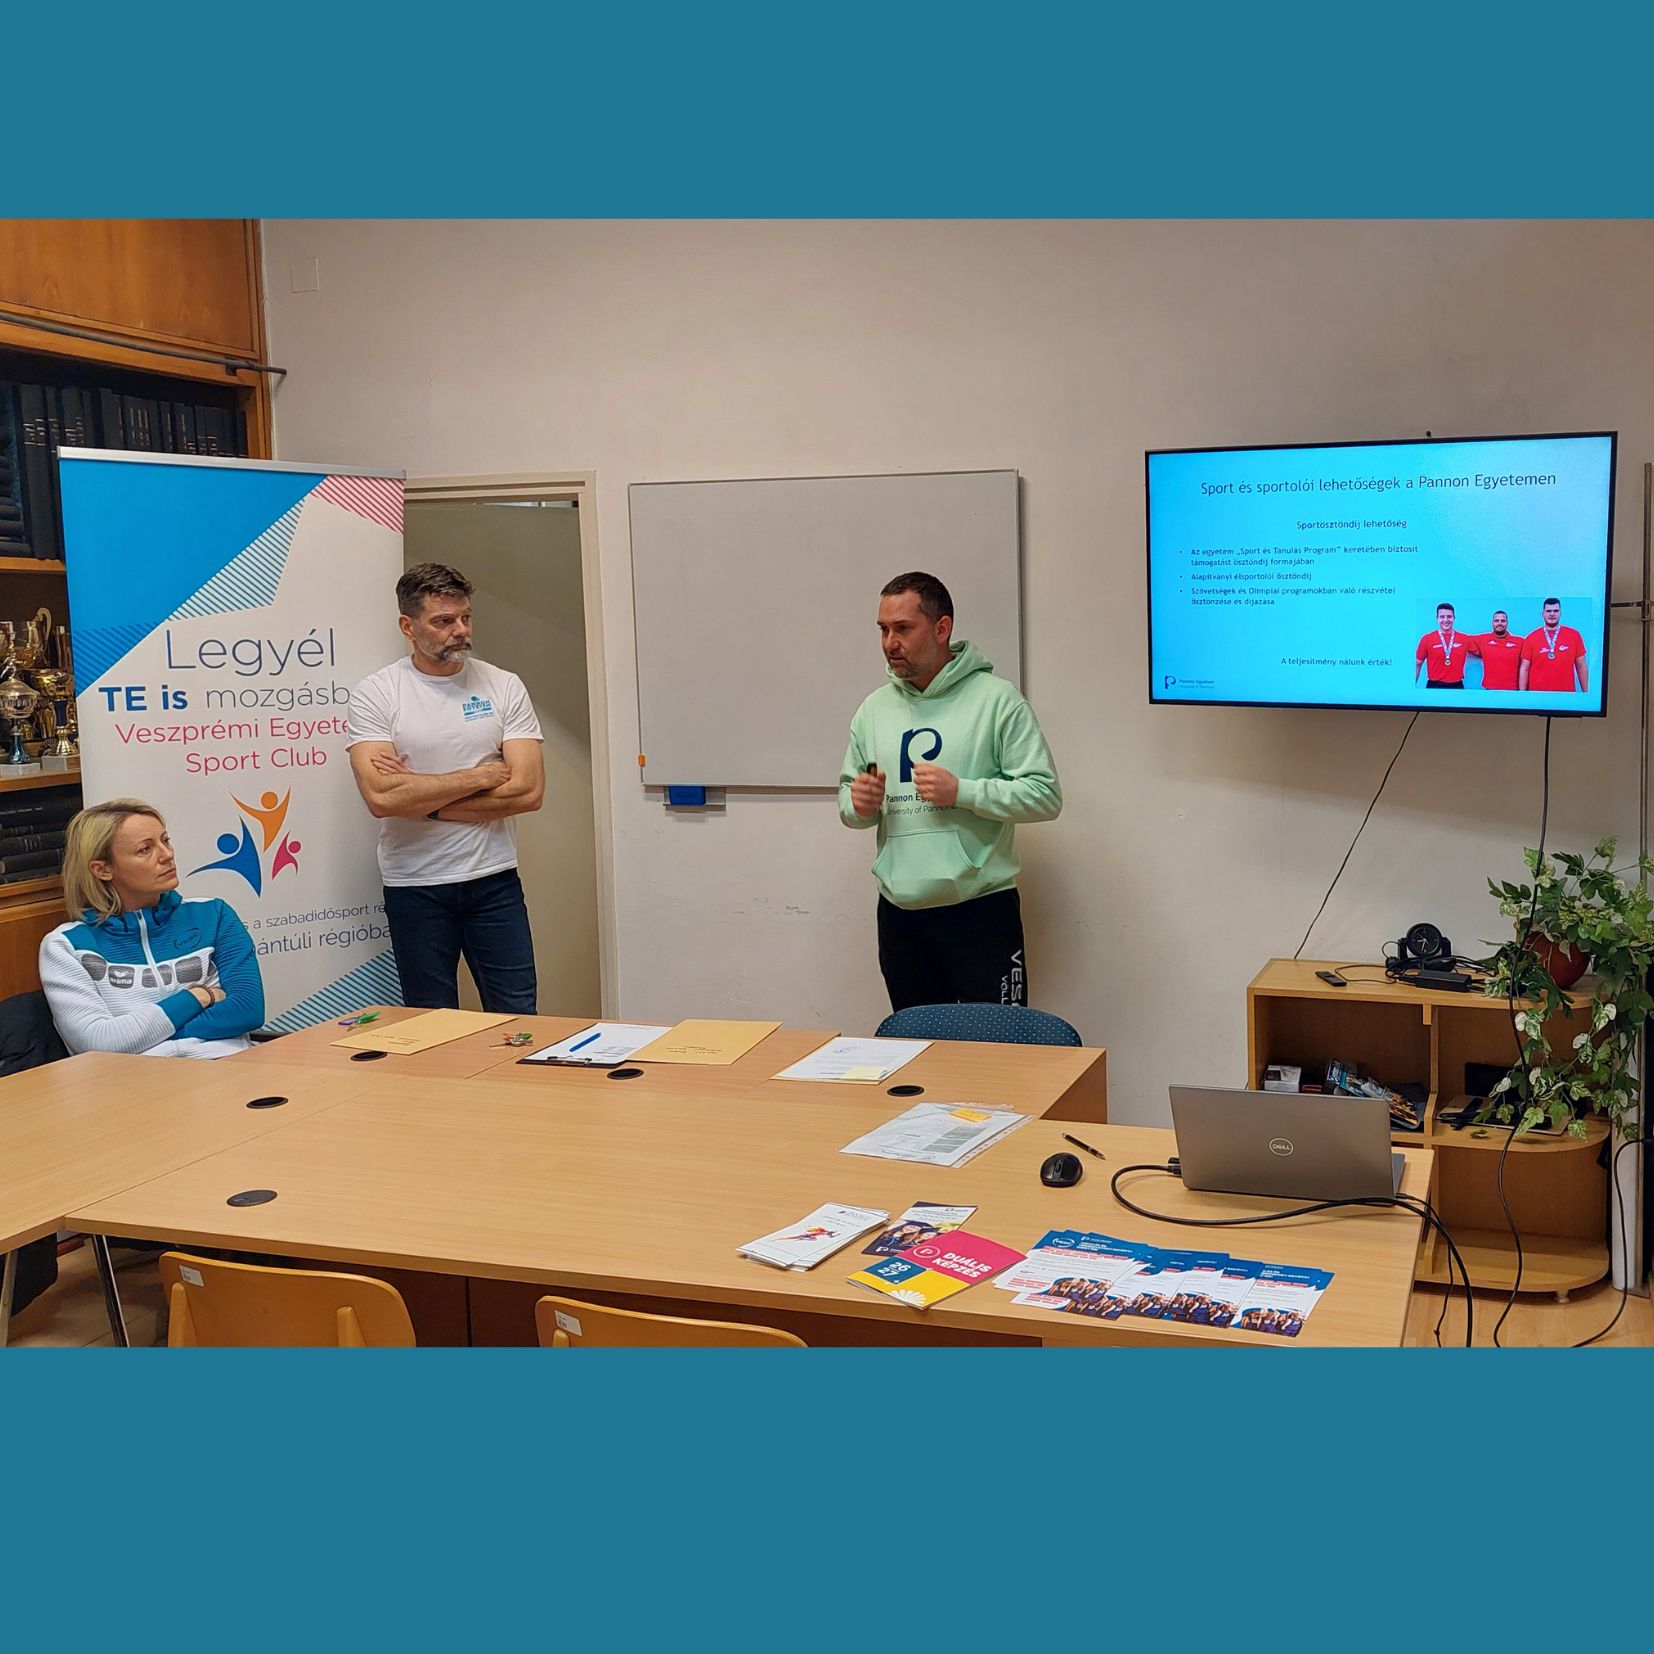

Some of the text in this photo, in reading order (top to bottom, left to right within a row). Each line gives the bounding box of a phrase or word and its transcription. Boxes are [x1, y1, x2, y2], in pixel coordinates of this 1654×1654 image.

[1201, 474, 1556, 496] Sport és sportolói lehetőségek a Pannon Egyetemen
[1363, 519, 1407, 529] lehetőség
[1202, 548, 1234, 557] egyetem
[1273, 546, 1302, 554] Tanulás
[166, 627, 335, 676] Legyél
[1281, 657, 1287, 665] A
[1339, 658, 1366, 666] nálunk
[99, 686, 147, 712] TE
[161, 684, 188, 710] is
[115, 718, 259, 745] Veszprémi
[186, 746, 327, 776] Sport Club
[886, 793, 914, 803] Pannon
[253, 919, 261, 929] a
[1272, 1143, 1291, 1151] DELL
[888, 1261, 911, 1272] 26
[931, 1257, 981, 1278] KÉPZÉS
[942, 1252, 992, 1273] DUÁLIS
